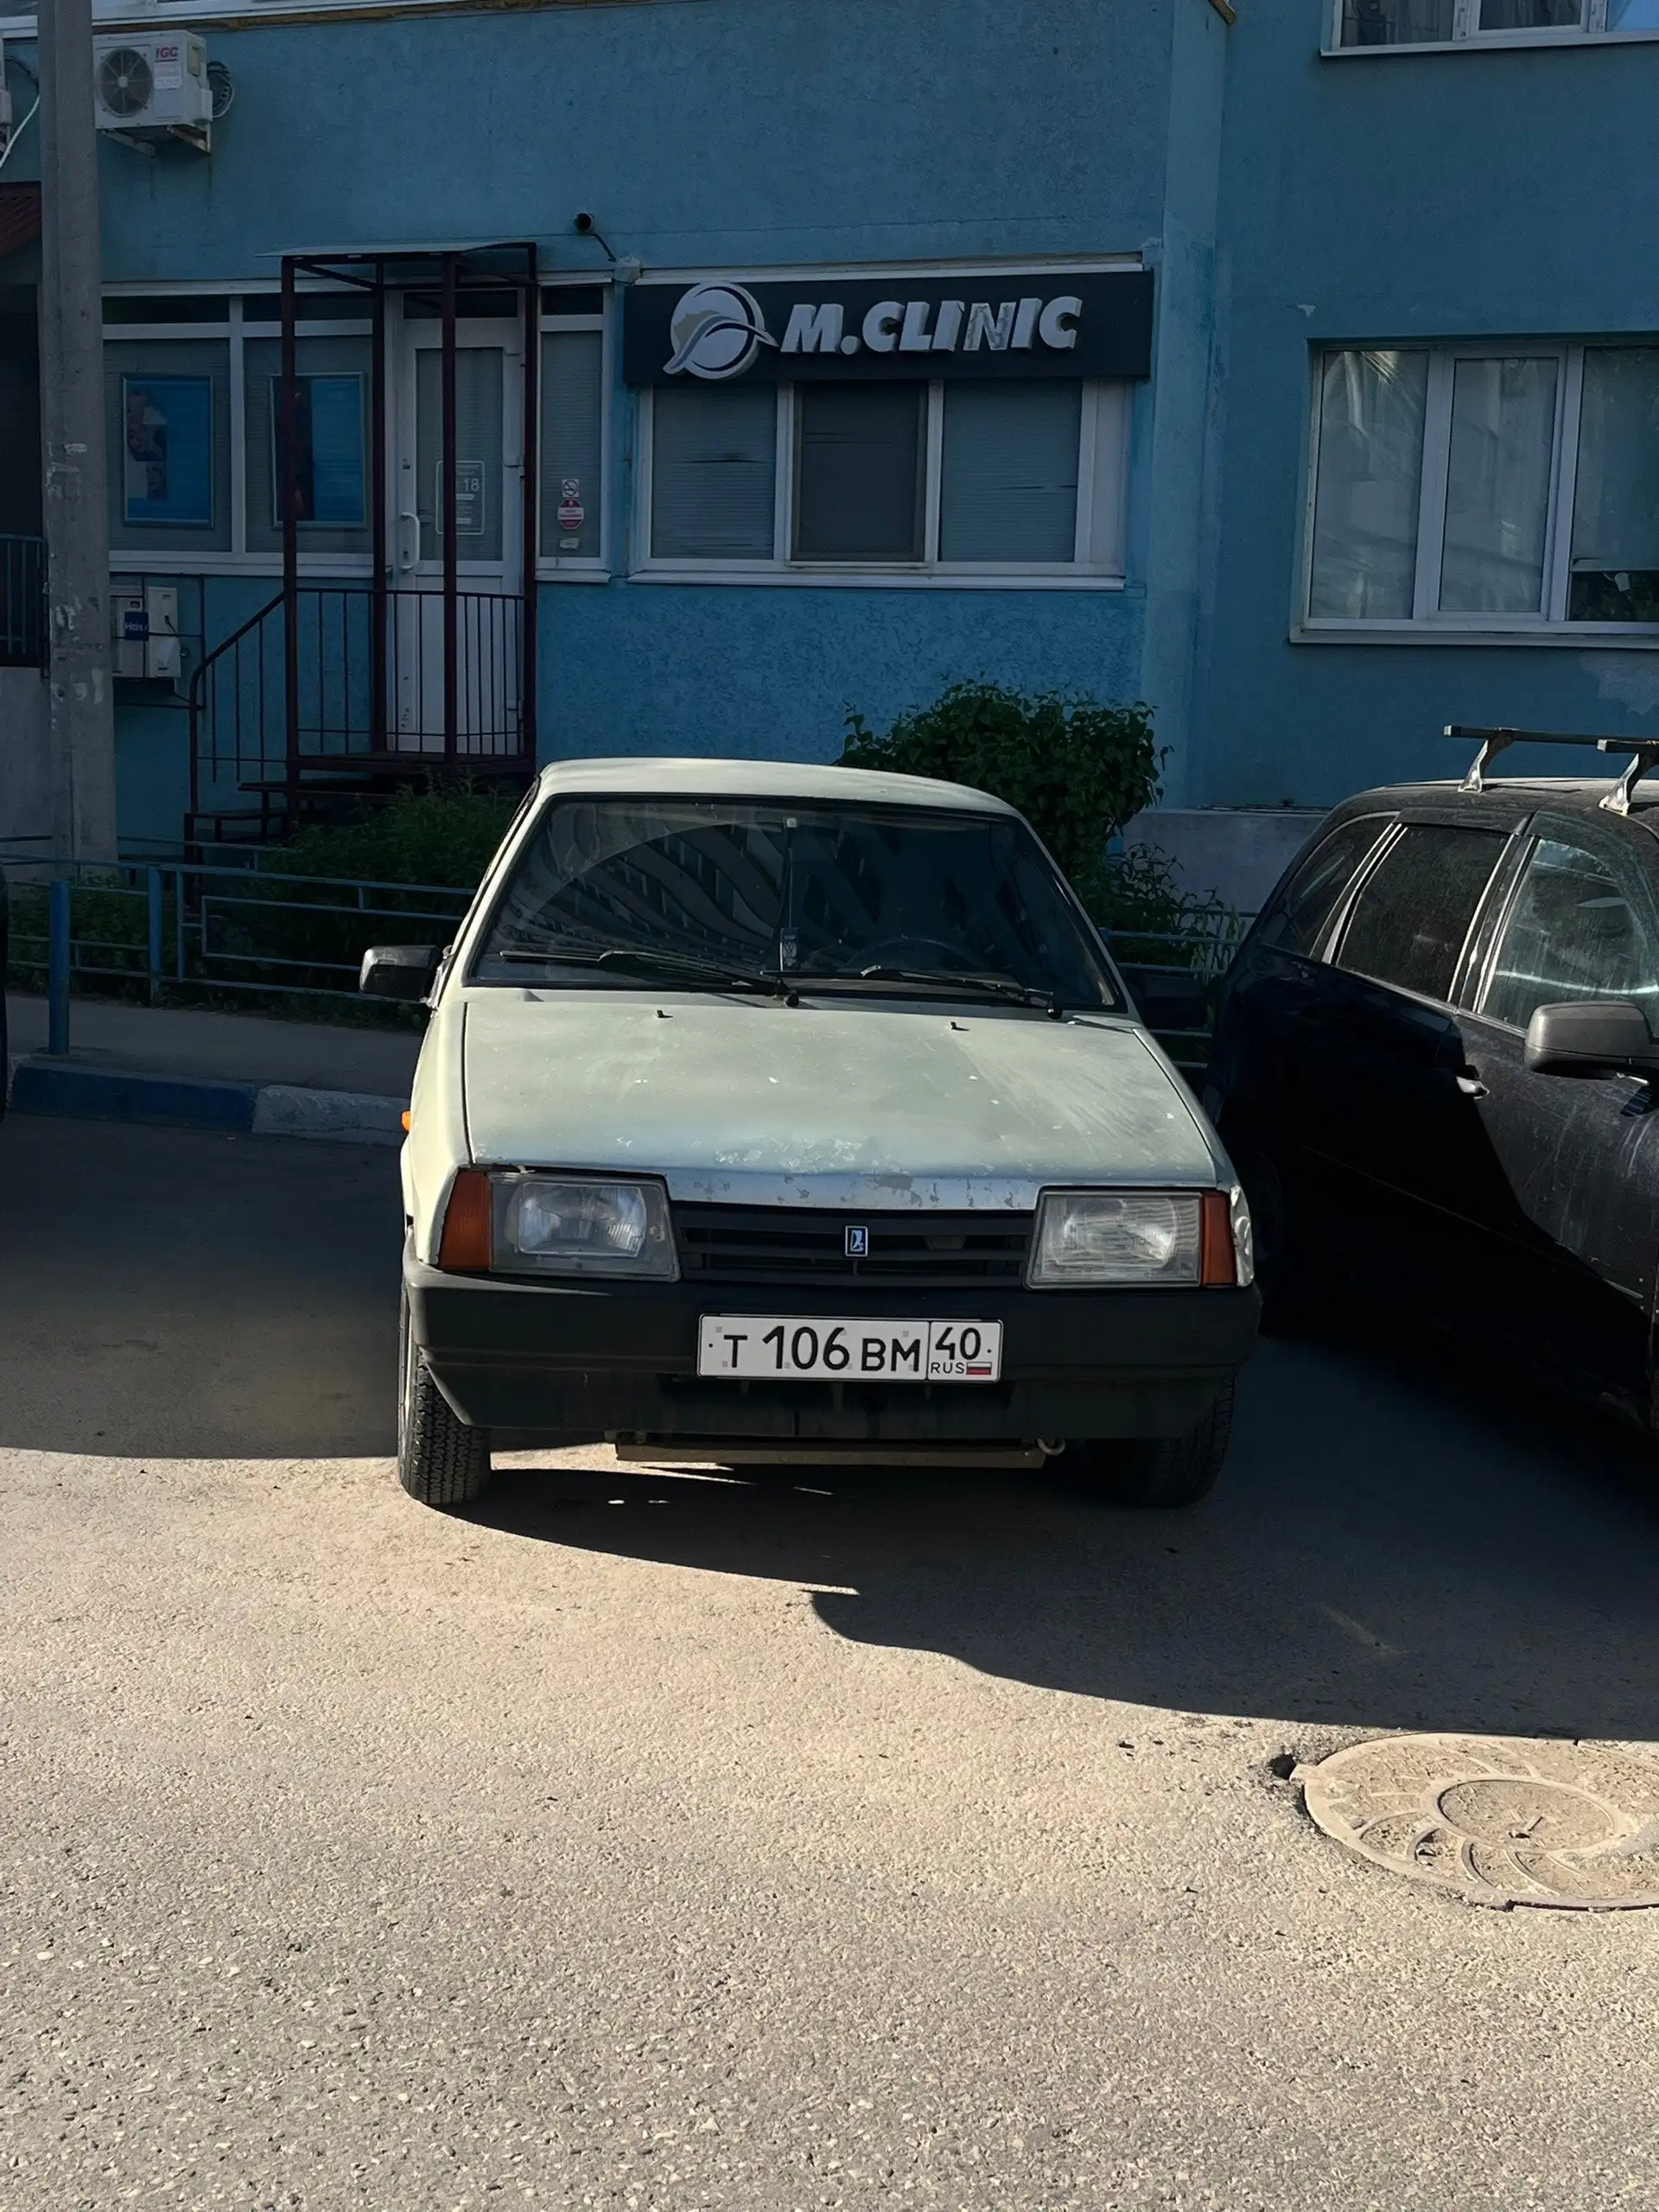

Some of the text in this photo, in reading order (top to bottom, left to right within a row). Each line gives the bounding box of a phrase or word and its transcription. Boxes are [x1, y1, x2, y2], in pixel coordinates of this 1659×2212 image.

[155, 46, 179, 59] IGC
[779, 296, 1084, 355] M.CLINIC
[935, 1326, 982, 1361] 40
[931, 1362, 965, 1376] RUS
